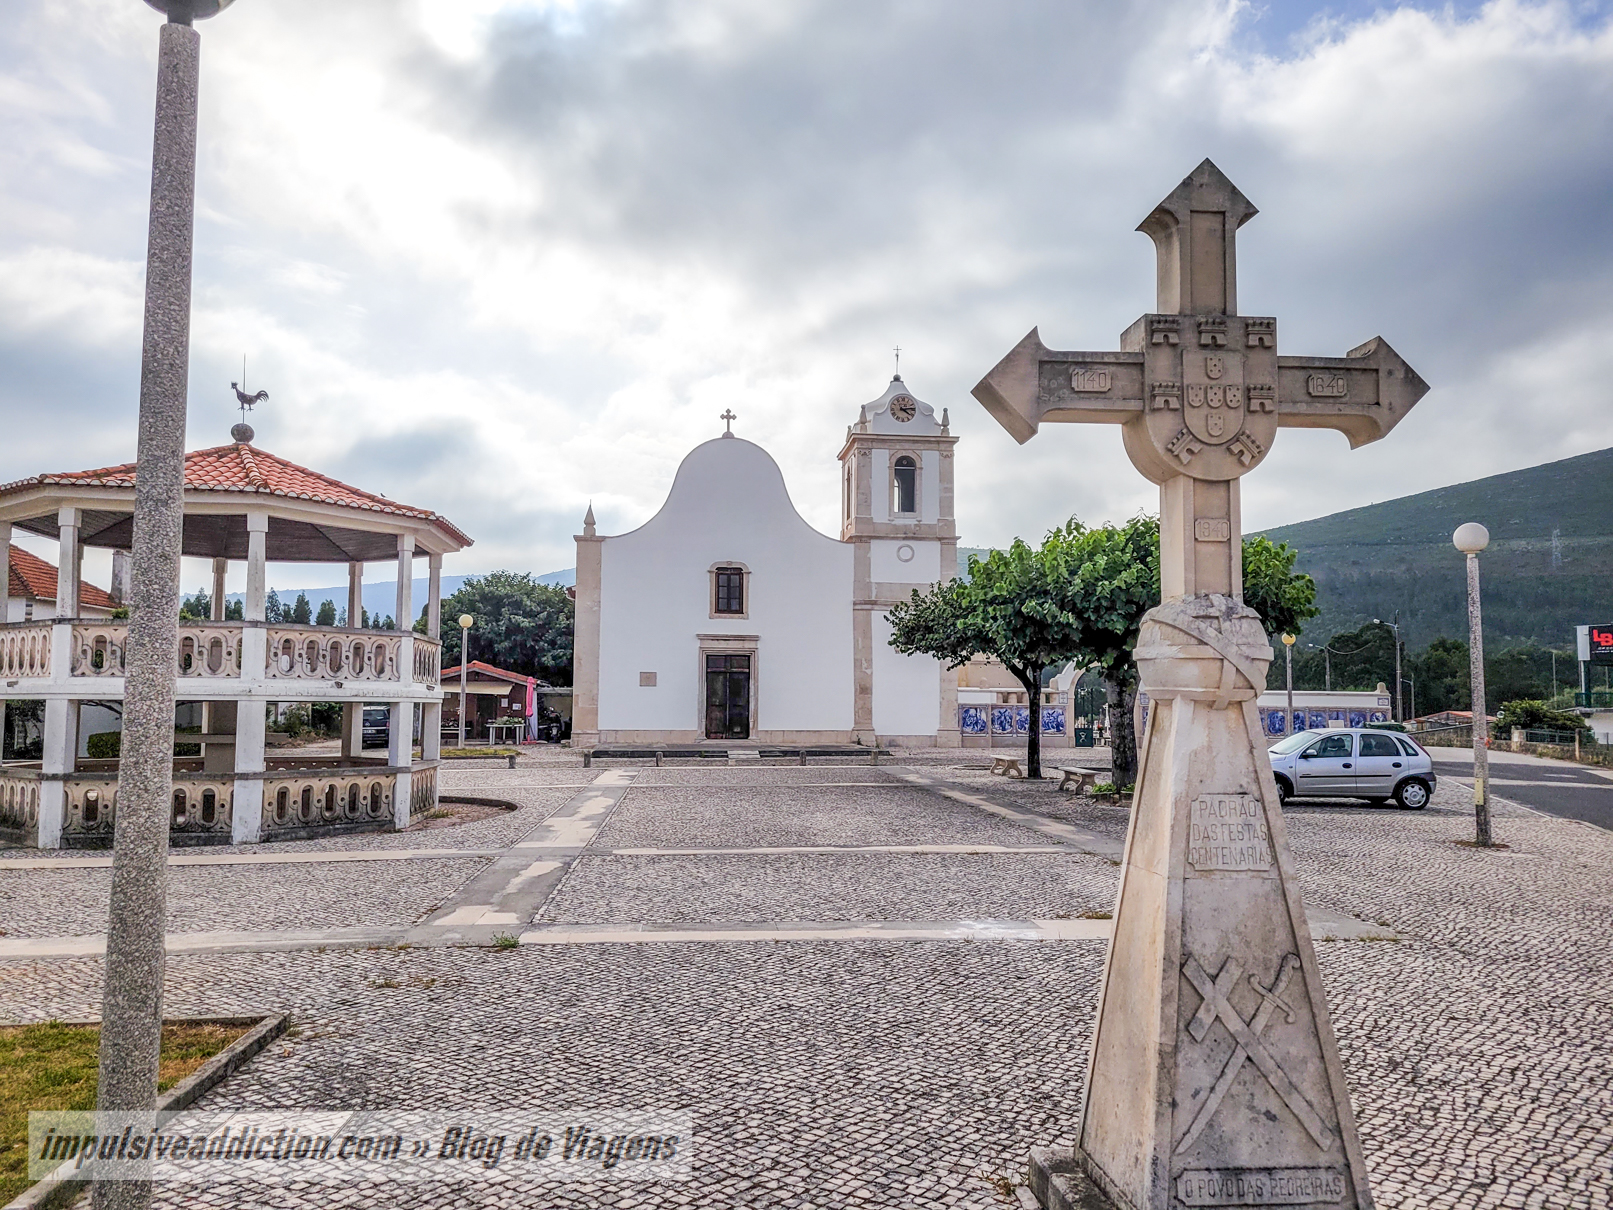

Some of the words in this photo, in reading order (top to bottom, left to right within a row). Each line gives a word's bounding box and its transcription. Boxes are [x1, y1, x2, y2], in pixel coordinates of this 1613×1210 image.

[1074, 371, 1107, 389] 1140
[1310, 375, 1345, 394] 1640
[1196, 521, 1229, 538] 1940
[1192, 823, 1218, 842] DAS
[1221, 823, 1267, 841] FESTAS
[1191, 846, 1273, 865] CENTENARIAS
[1185, 1178, 1194, 1198] O
[1199, 1178, 1234, 1198] POVO
[1237, 1178, 1264, 1198] DAS
[1269, 1176, 1343, 1198] PEDREIRAS
